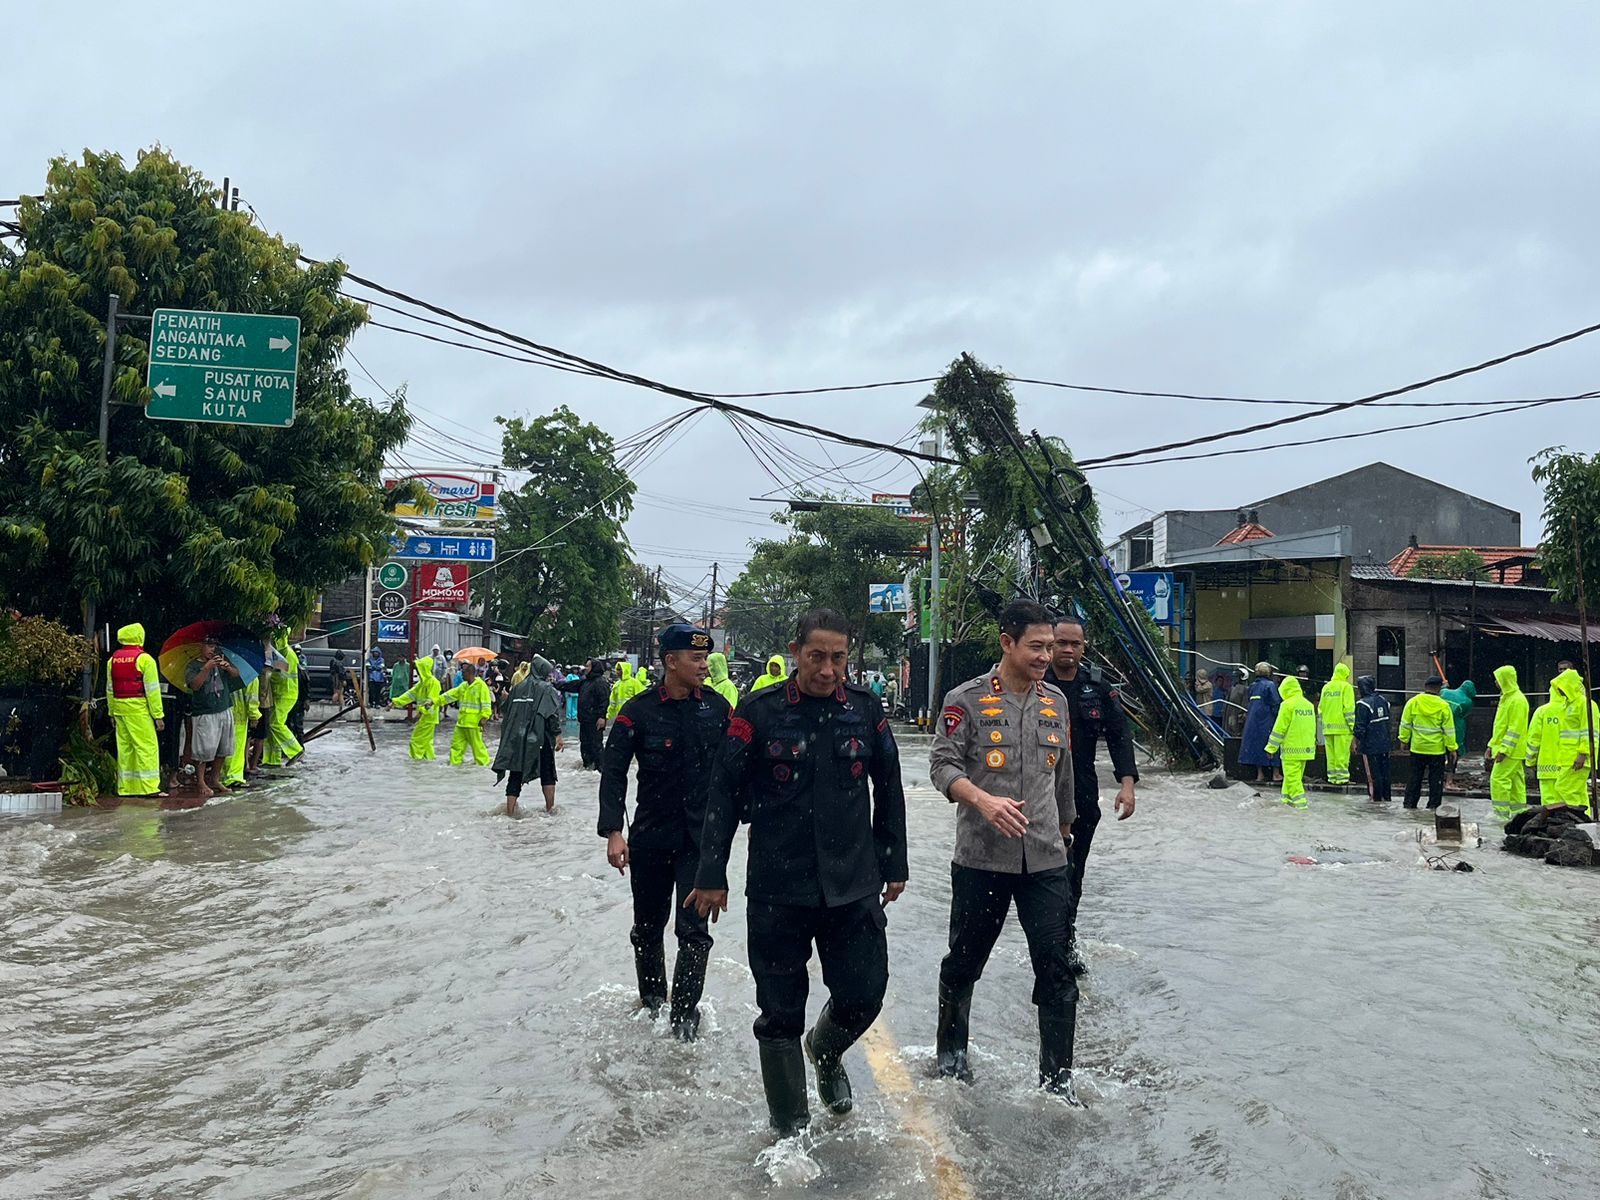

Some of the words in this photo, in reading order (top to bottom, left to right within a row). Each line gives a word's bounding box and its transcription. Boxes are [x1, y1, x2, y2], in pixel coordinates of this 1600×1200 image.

[157, 314, 221, 331] PENATIH
[157, 330, 246, 348] ANGANTAKA
[155, 345, 221, 361] SEDANG
[204, 371, 251, 387] PUSAT
[255, 374, 290, 390] KOTA
[204, 387, 263, 403] SANUR
[202, 402, 247, 418] KUTA
[422, 588, 465, 597] MOMOYO
